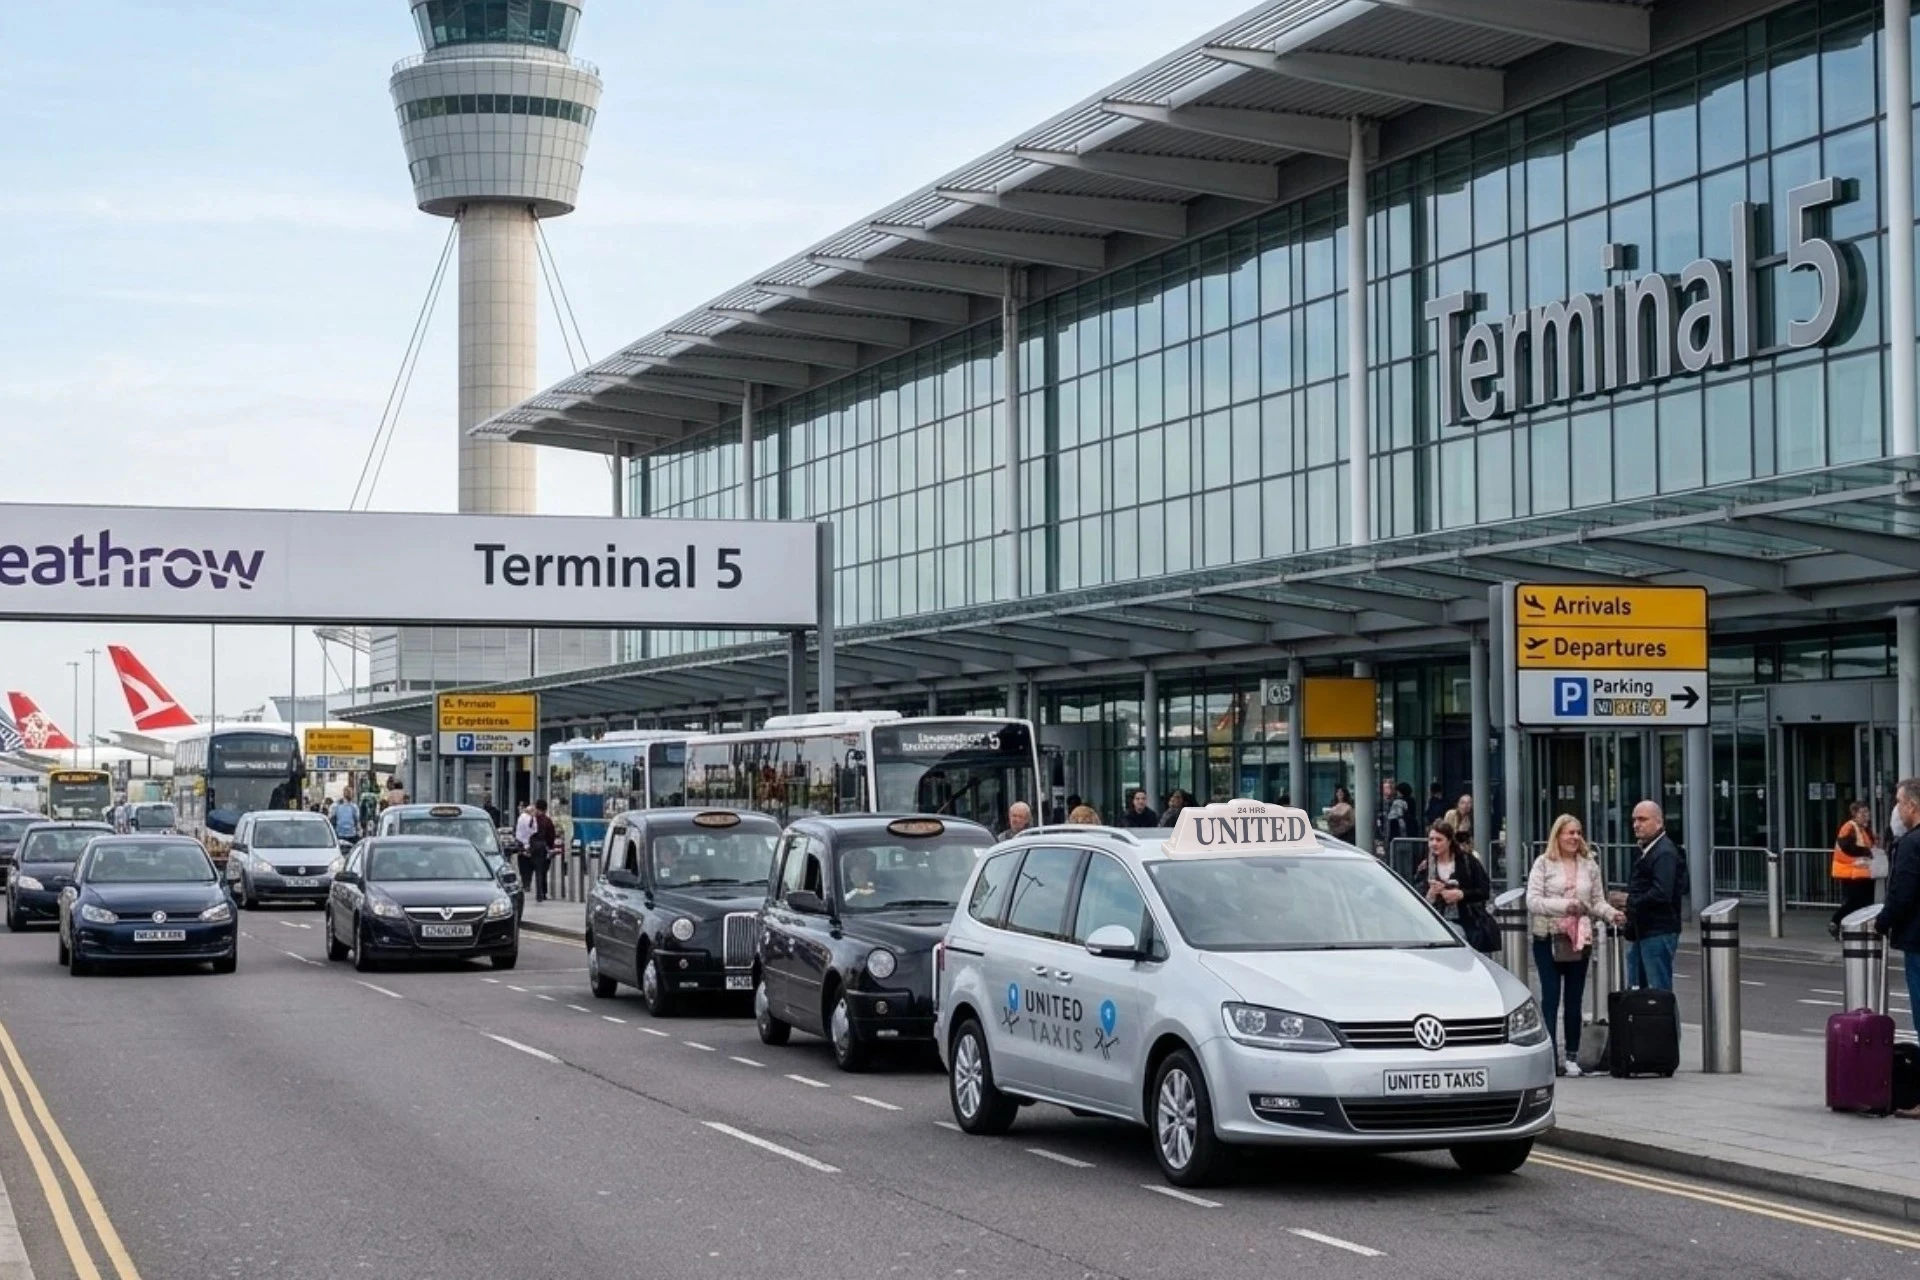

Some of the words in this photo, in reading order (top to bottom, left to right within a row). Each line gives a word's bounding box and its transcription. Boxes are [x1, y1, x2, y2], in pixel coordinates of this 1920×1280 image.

[1425, 201, 1760, 427] Terminal
[1787, 176, 1853, 348] 5
[474, 543, 696, 589] Terminal
[716, 548, 743, 589] 5
[1553, 595, 1632, 616] Arrivals
[1554, 637, 1667, 661] Departures
[1562, 682, 1582, 712] P
[1593, 678, 1653, 697] Parking
[1237, 806, 1247, 814] 24
[1249, 806, 1266, 814] HRS
[1193, 816, 1306, 846] UNITED
[1025, 989, 1083, 1022] UNITED
[1029, 1018, 1084, 1053] TAXIS
[1387, 1074, 1440, 1091] UNITED
